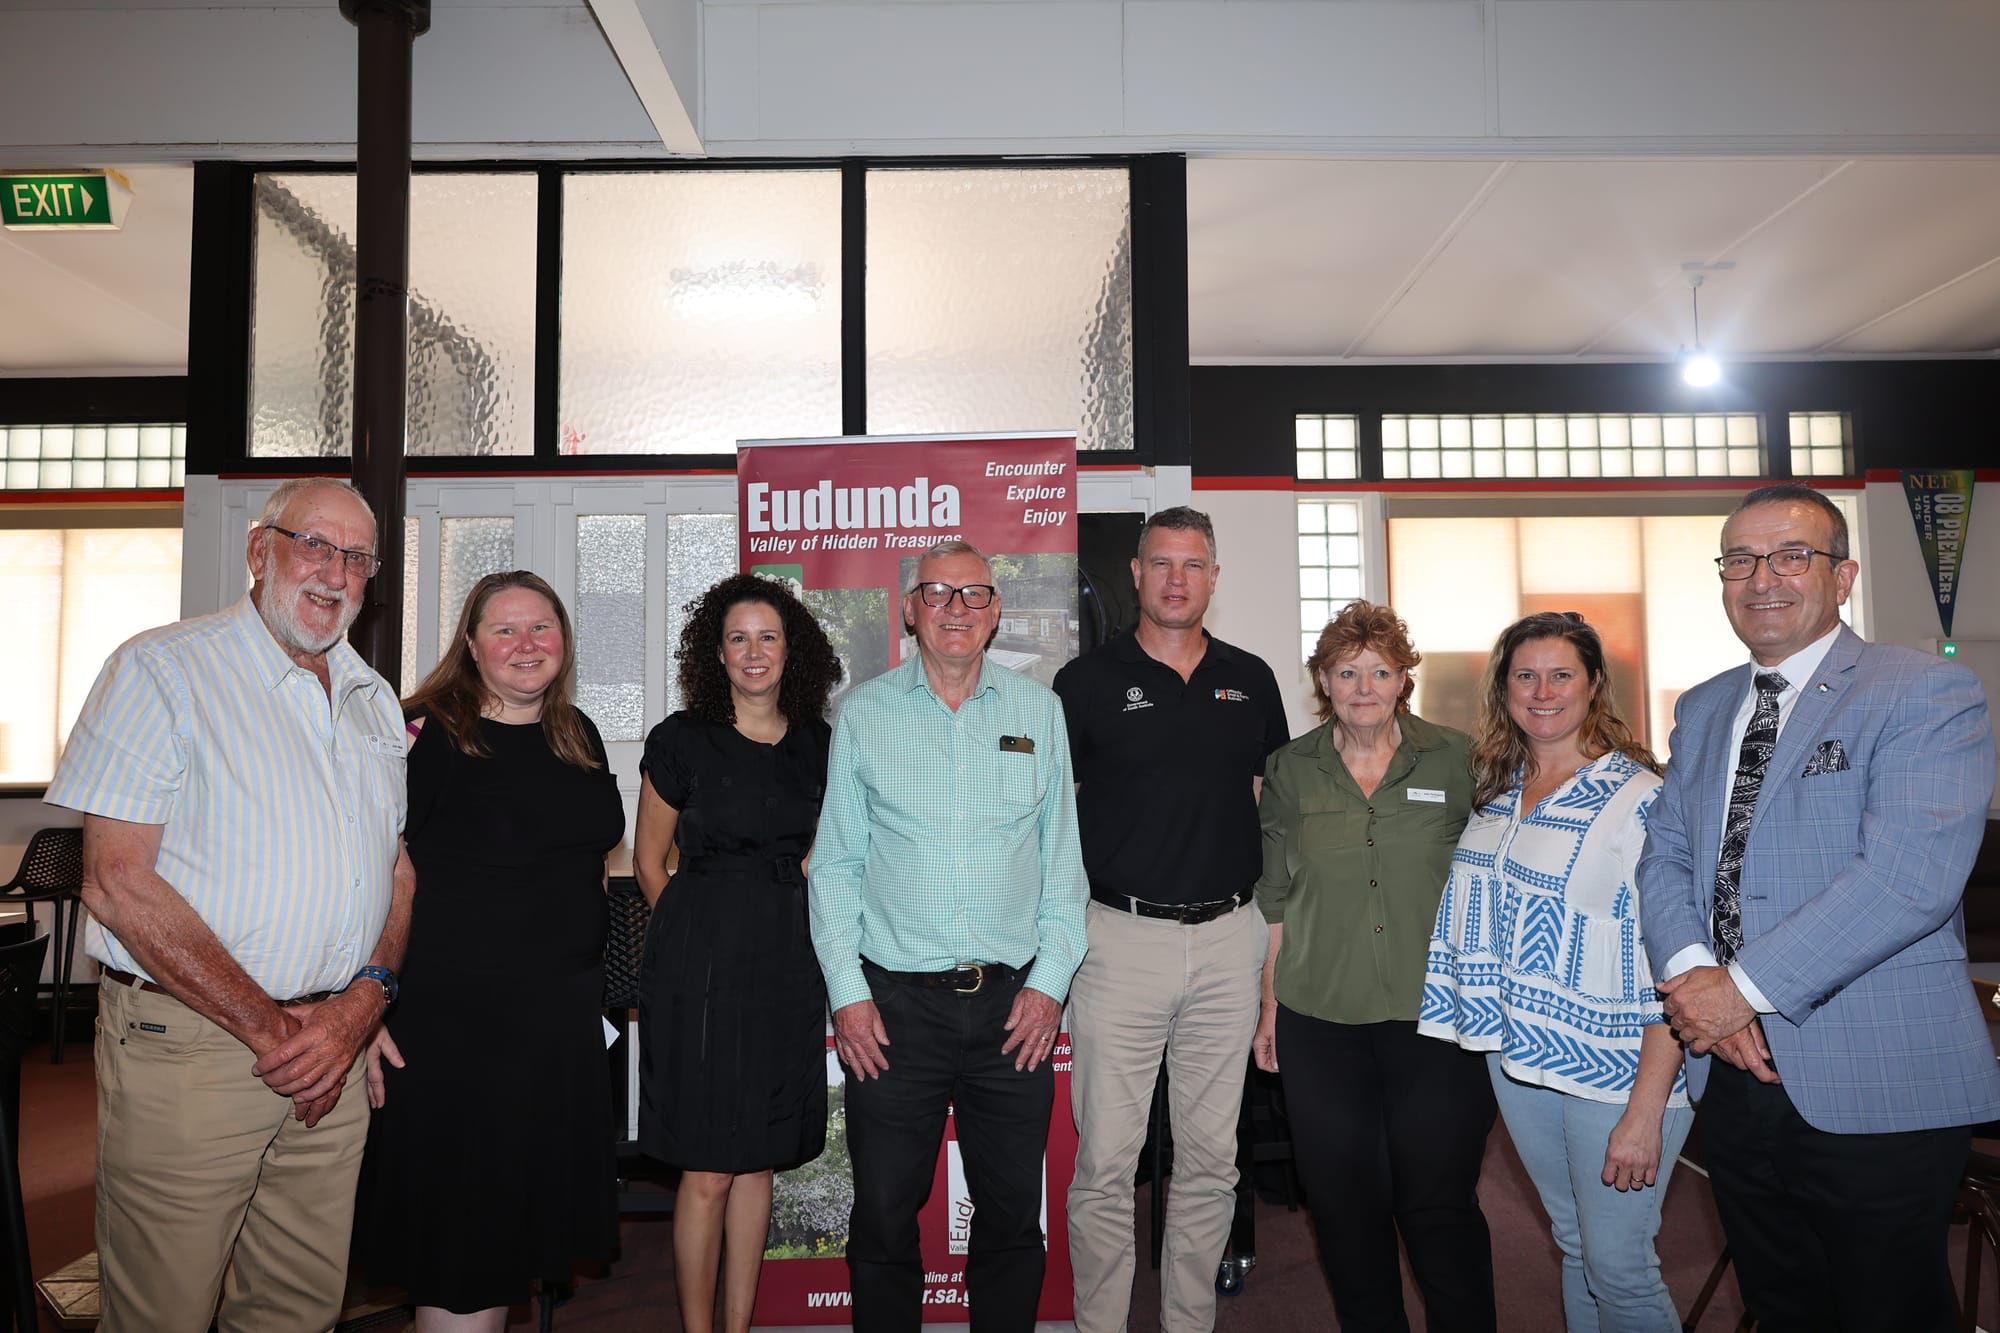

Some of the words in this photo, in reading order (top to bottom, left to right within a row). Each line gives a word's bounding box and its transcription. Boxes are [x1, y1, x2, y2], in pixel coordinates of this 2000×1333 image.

[12, 183, 74, 217] EXIT
[985, 461, 1066, 477] Encounter
[1909, 474, 1967, 489] NEFL
[1006, 485, 1066, 503] Explore
[1934, 493, 1966, 514] 08
[747, 477, 961, 533] Eudunda
[1023, 508, 1067, 527] Enjoy
[1922, 494, 1932, 541] UNDER
[750, 537, 797, 555] Valley
[801, 535, 819, 550] of
[822, 534, 878, 550] Hidden
[1936, 518, 1962, 604] PREMIERS
[951, 1271, 963, 1283] at
